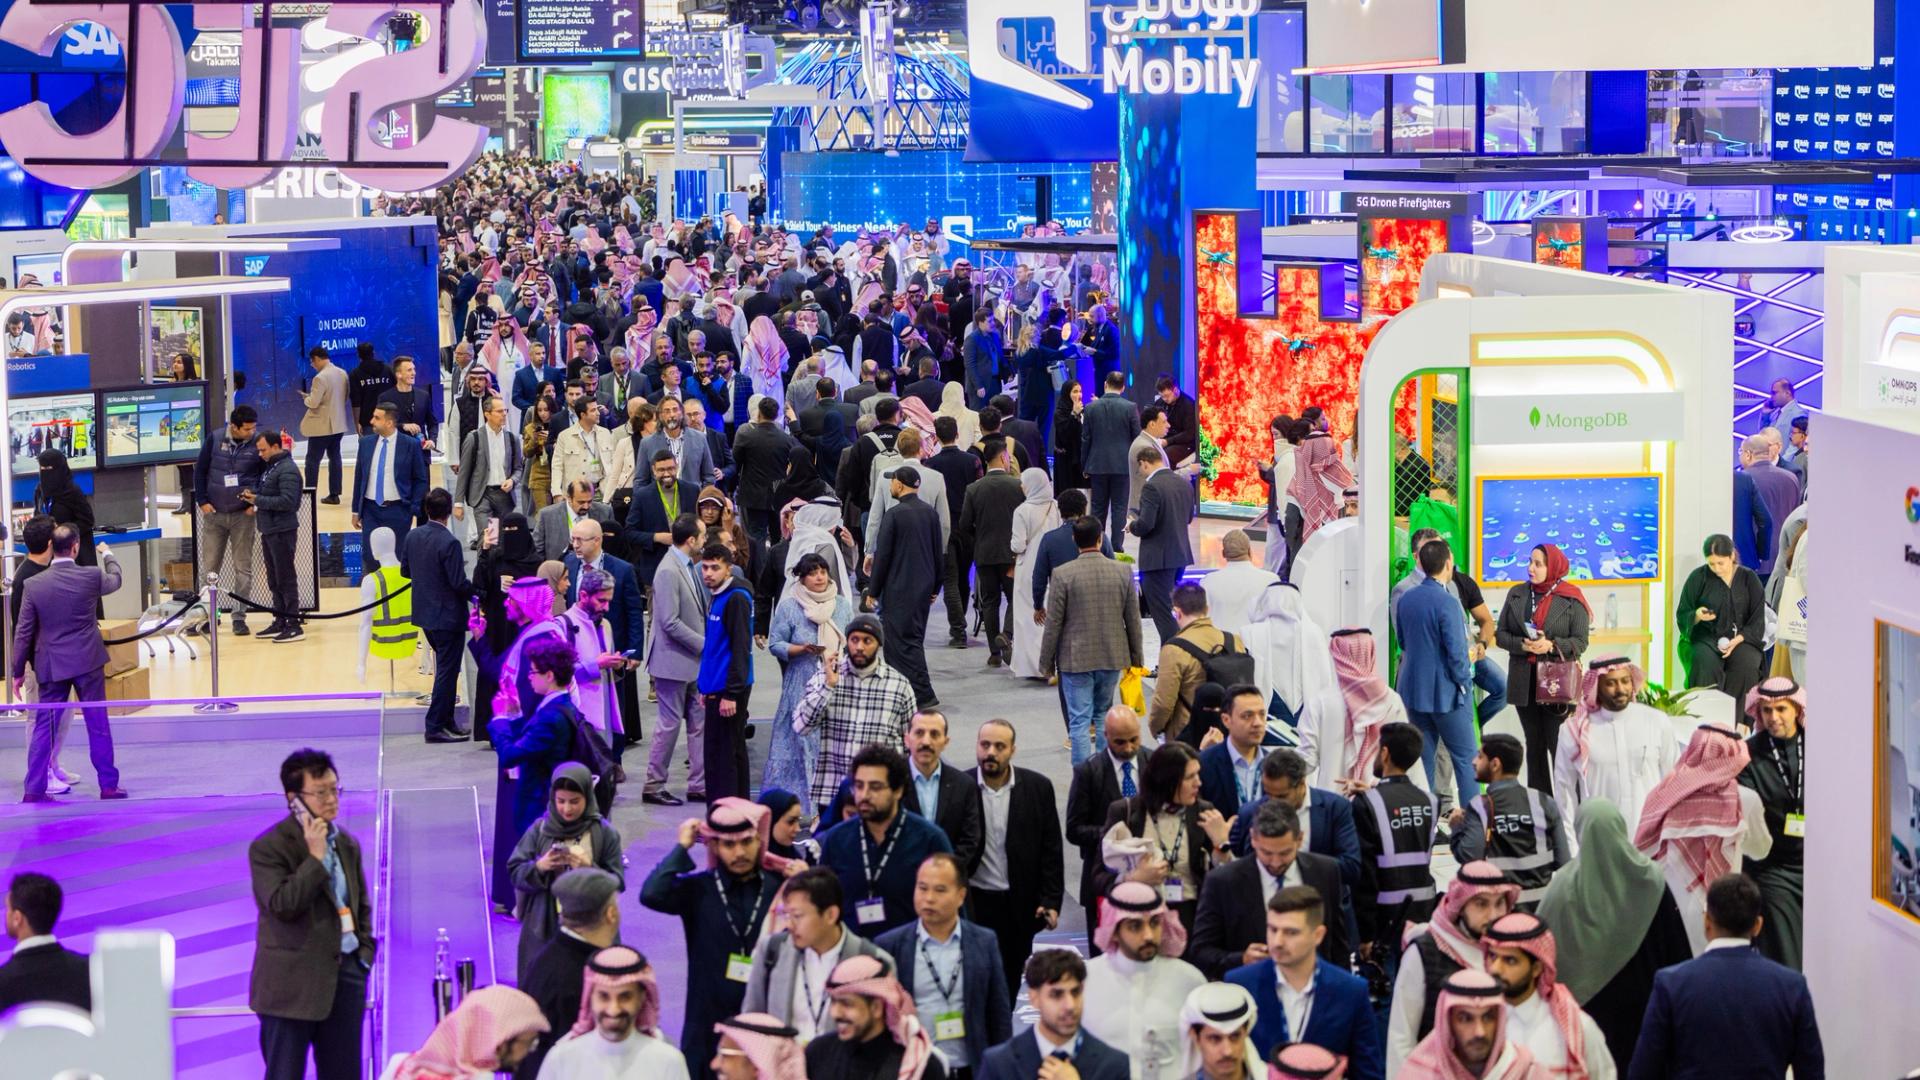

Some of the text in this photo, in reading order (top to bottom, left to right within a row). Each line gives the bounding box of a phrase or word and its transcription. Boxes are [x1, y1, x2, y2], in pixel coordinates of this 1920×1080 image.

[205, 57, 240, 66] Takamol
[1102, 45, 1261, 108] Mobily
[252, 166, 437, 198] ERICS
[1357, 197, 1451, 210] 5G Drone Firefighters
[1065, 217, 1082, 229] You
[245, 260, 264, 275] SAP
[332, 316, 366, 330] DEMAND
[1546, 412, 1628, 431] MongoDB
[1400, 805, 1432, 817] REC
[1391, 816, 1423, 829] ORD
[1495, 822, 1519, 834] RD
